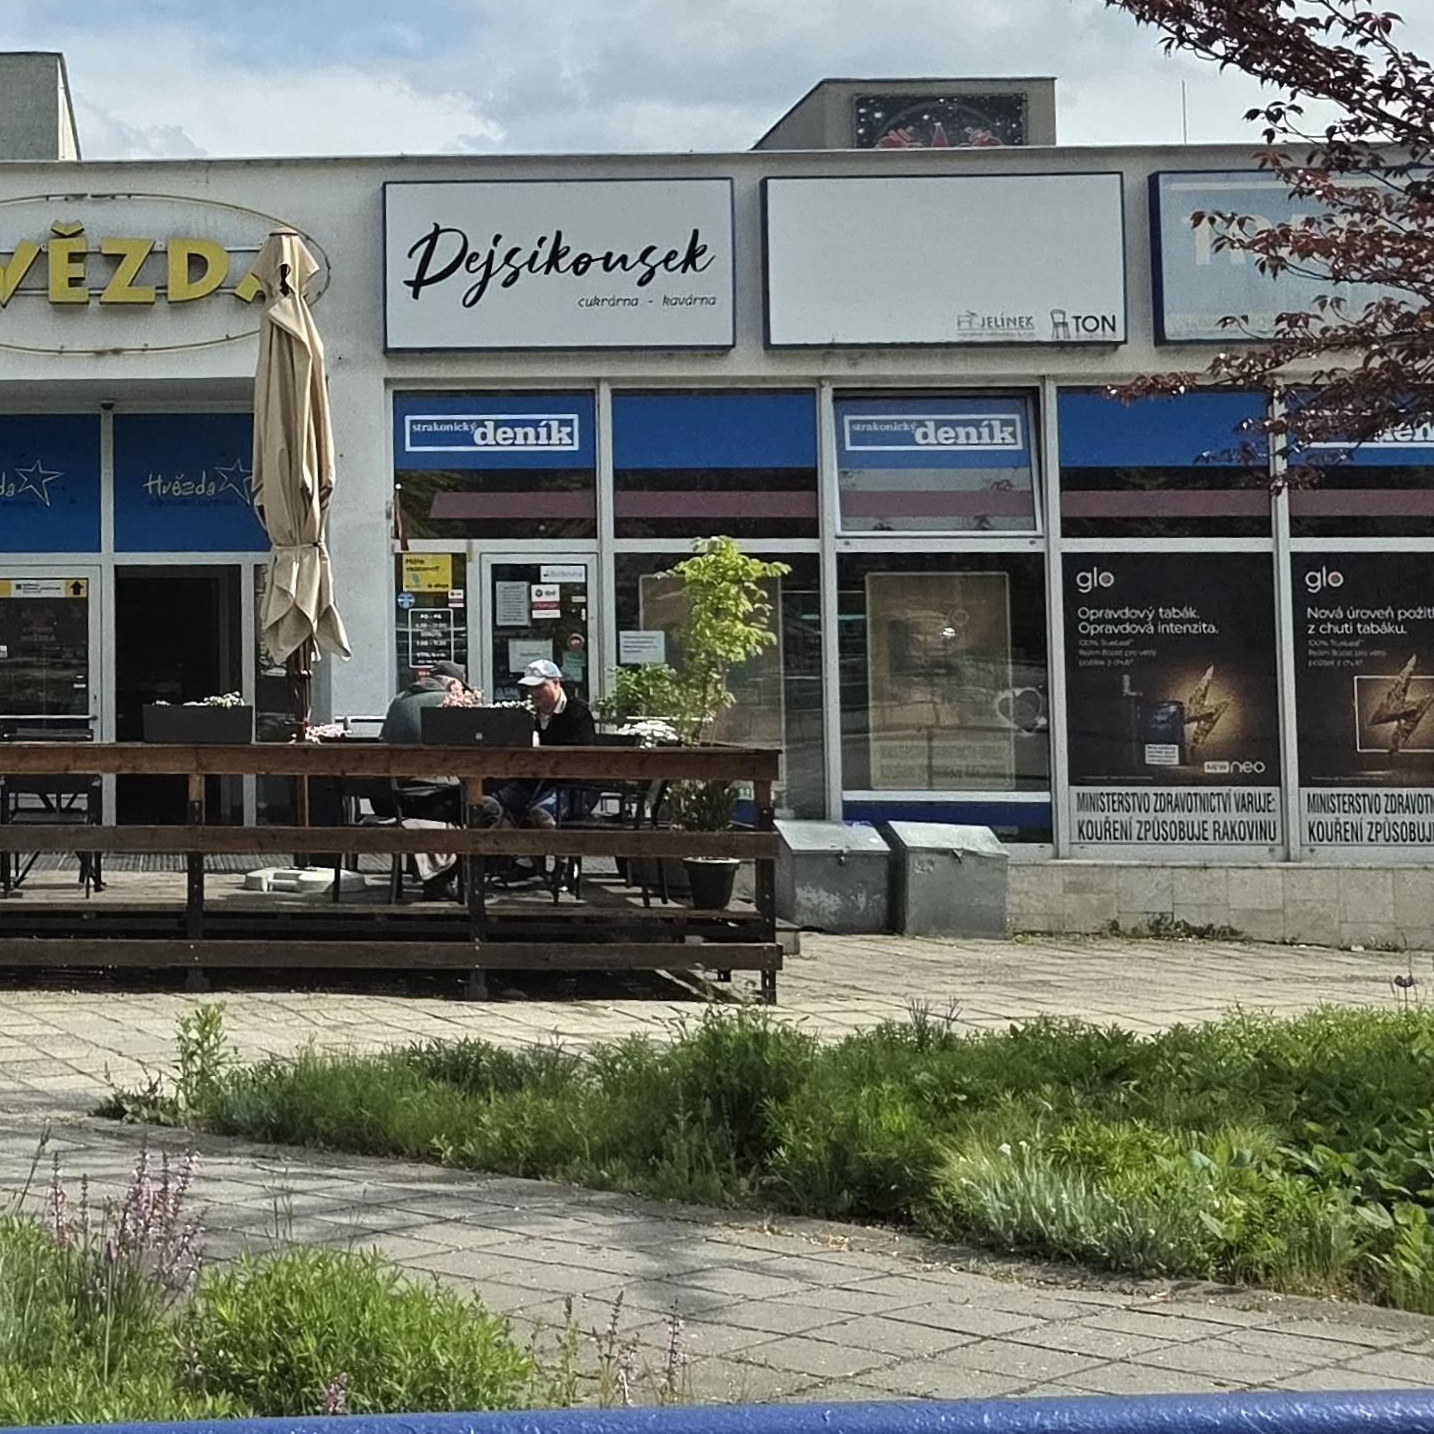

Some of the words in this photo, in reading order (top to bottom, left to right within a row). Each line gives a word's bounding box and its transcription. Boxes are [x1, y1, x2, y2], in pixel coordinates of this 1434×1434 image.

[403, 222, 716, 308] Dejsikousek
[577, 295, 639, 307] cukrárna
[662, 294, 717, 307] kavárna
[980, 313, 1035, 328] JELÍNEK
[1072, 315, 1116, 333] TON
[412, 422, 477, 434] strakonický
[473, 420, 572, 445] deník
[915, 420, 1015, 445] deník
[142, 471, 215, 498] Hvězda
[1076, 566, 1115, 593] glo
[1305, 566, 1344, 593] glo
[1077, 605, 1155, 621] Opravdový
[1158, 606, 1200, 620] tabák.
[1307, 606, 1343, 619] Nová
[1347, 606, 1394, 619] úroveň
[1078, 621, 1154, 636] Opravdová
[1158, 621, 1219, 634] intenzita.
[1308, 624, 1315, 634] z
[1319, 622, 1353, 634] chuti
[1230, 761, 1265, 774] neo
[1076, 792, 1150, 813] MINISTERSTVO
[1153, 788, 1233, 813] ZDRAVOTNICTVÍ
[1234, 792, 1276, 813] VARUJE:
[1307, 792, 1381, 814] MINISTERSTVO
[1078, 816, 1132, 841] KOUŘENÍ
[1136, 816, 1208, 841] ZPŮSOBUJE
[1213, 819, 1276, 841] RAKOVINU
[1308, 817, 1363, 842] KOUŘENÍ
